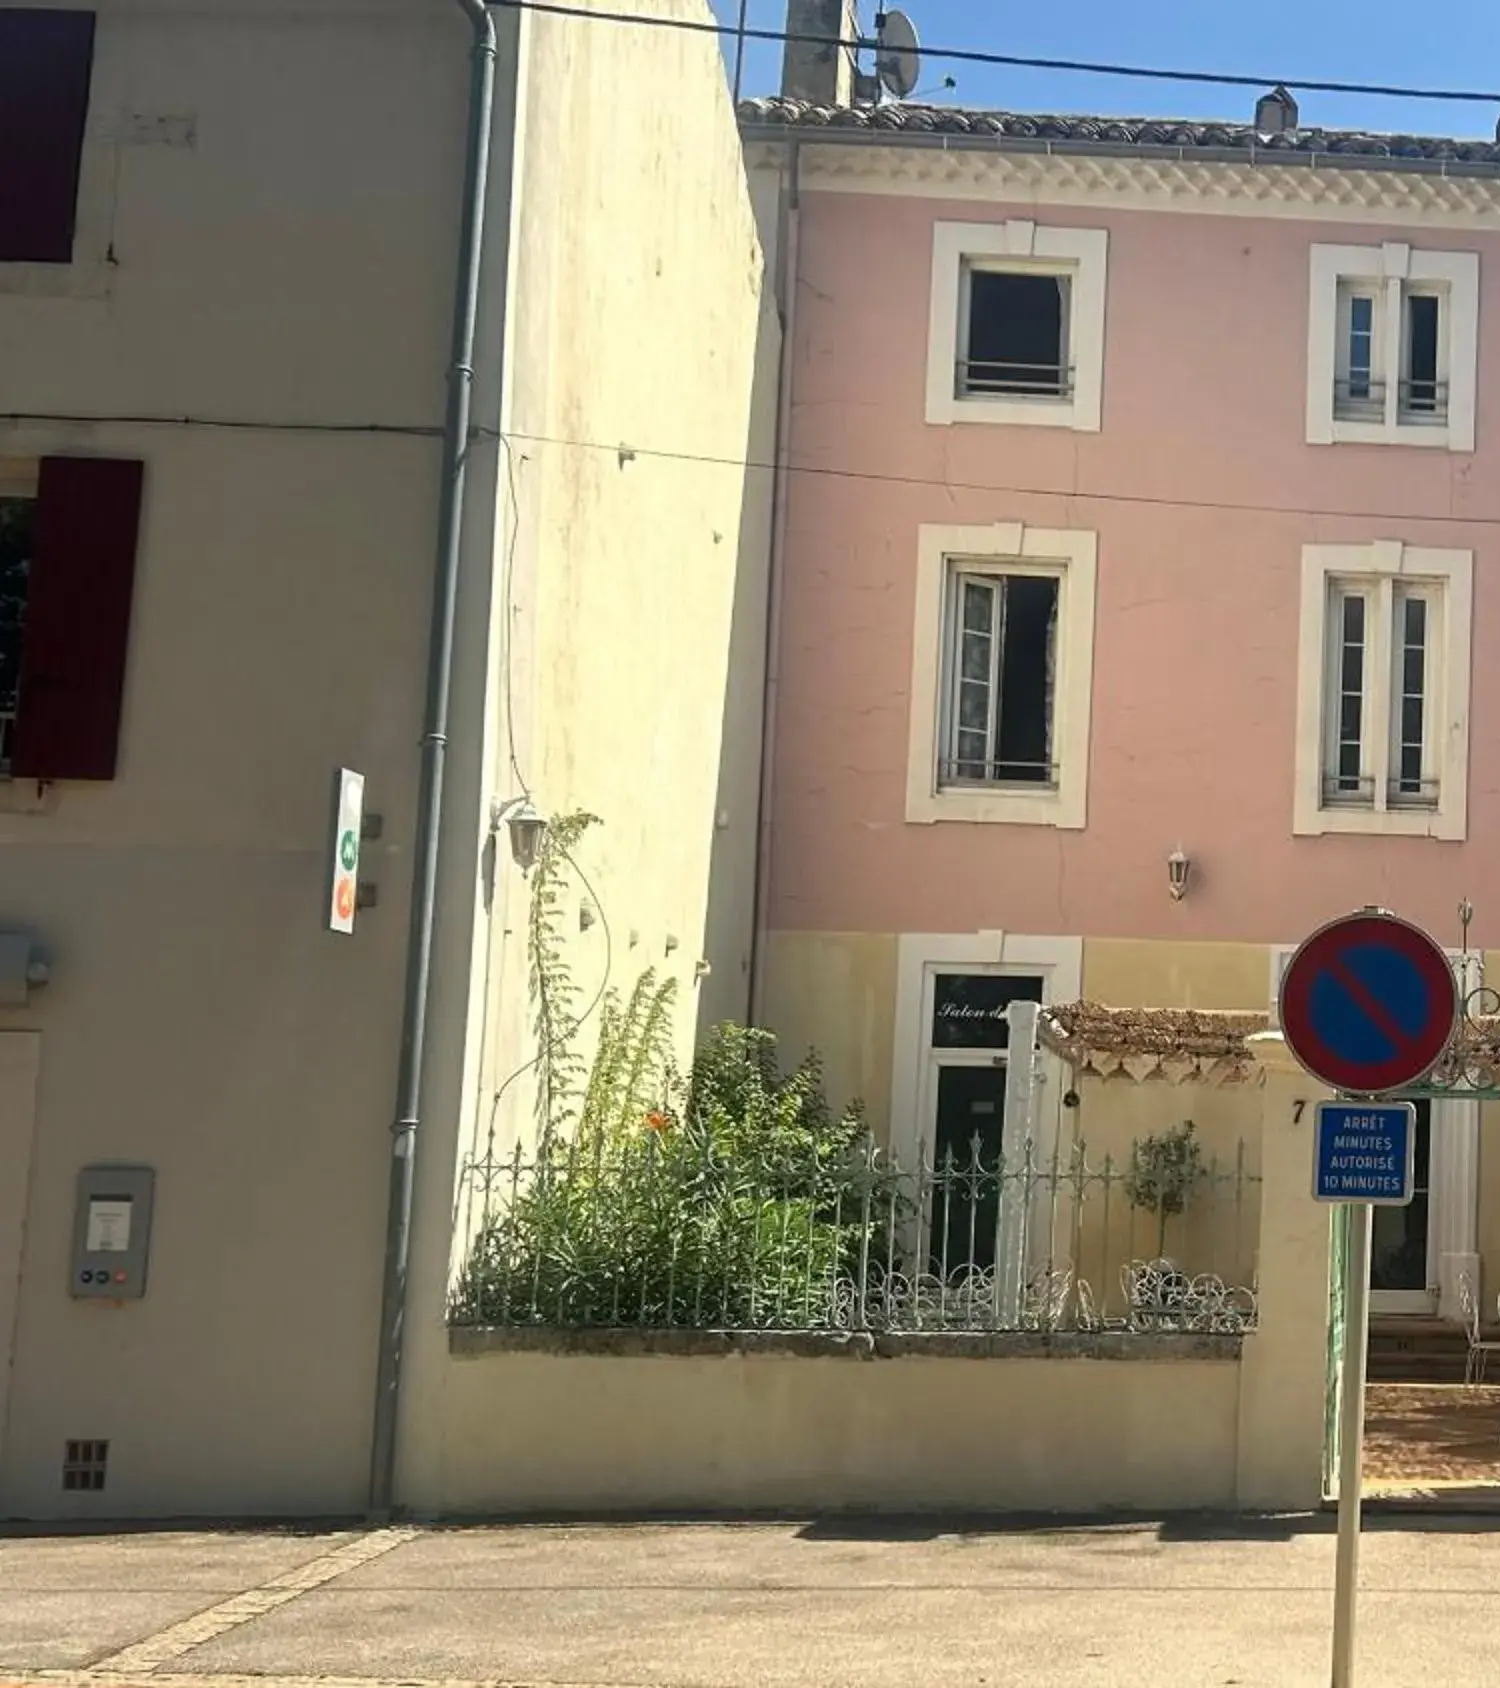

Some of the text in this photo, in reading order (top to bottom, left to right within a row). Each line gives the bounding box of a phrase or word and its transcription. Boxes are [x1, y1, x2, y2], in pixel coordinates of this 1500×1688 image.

[1292, 1100, 1306, 1125] 7
[1343, 1113, 1386, 1131] ARRÊT
[1334, 1135, 1392, 1151] MINUTES
[1324, 1175, 1401, 1191] 10 MINUTES
